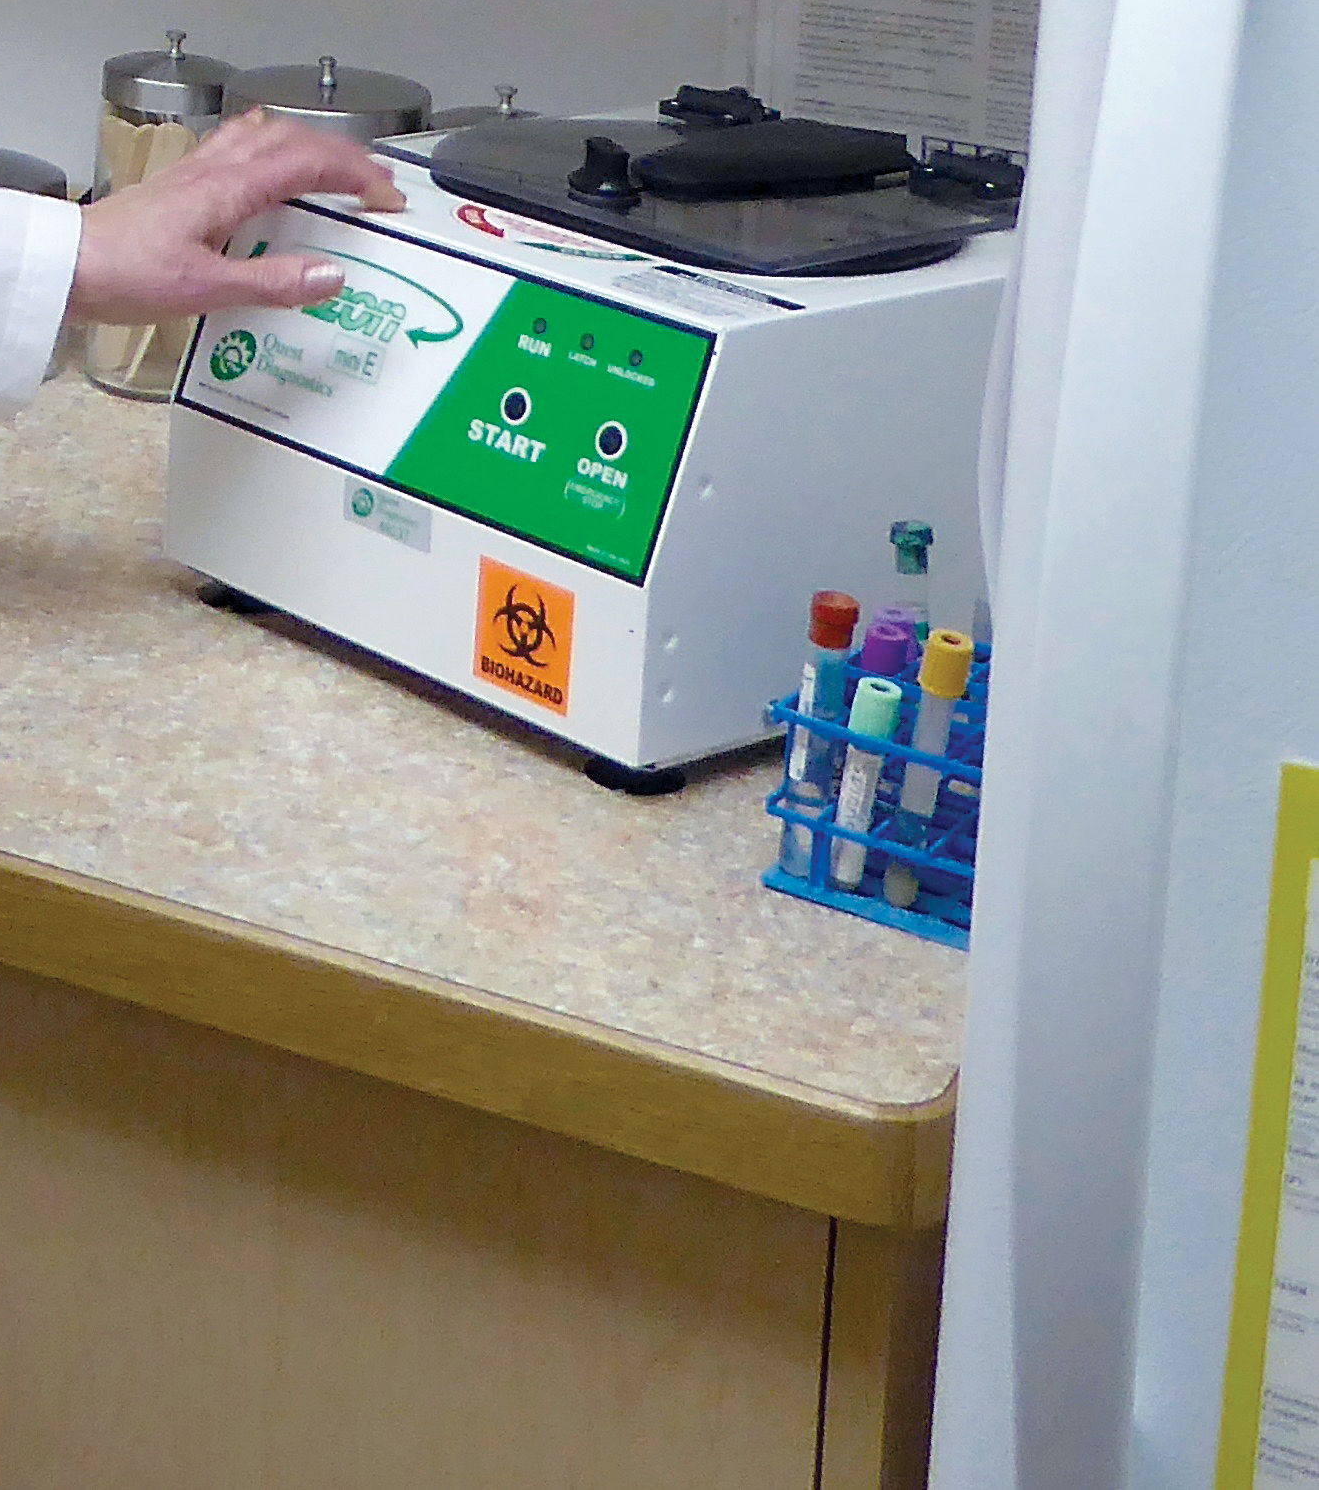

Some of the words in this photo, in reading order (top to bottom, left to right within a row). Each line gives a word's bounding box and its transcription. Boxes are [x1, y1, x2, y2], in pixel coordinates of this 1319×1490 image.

[264, 333, 304, 360] Quest
[517, 334, 552, 357] RUN
[257, 354, 334, 397] Diagnostics
[361, 351, 378, 377] E
[467, 418, 547, 462] START
[577, 457, 628, 489] OPEN
[481, 655, 562, 704] BIOHAZARD
